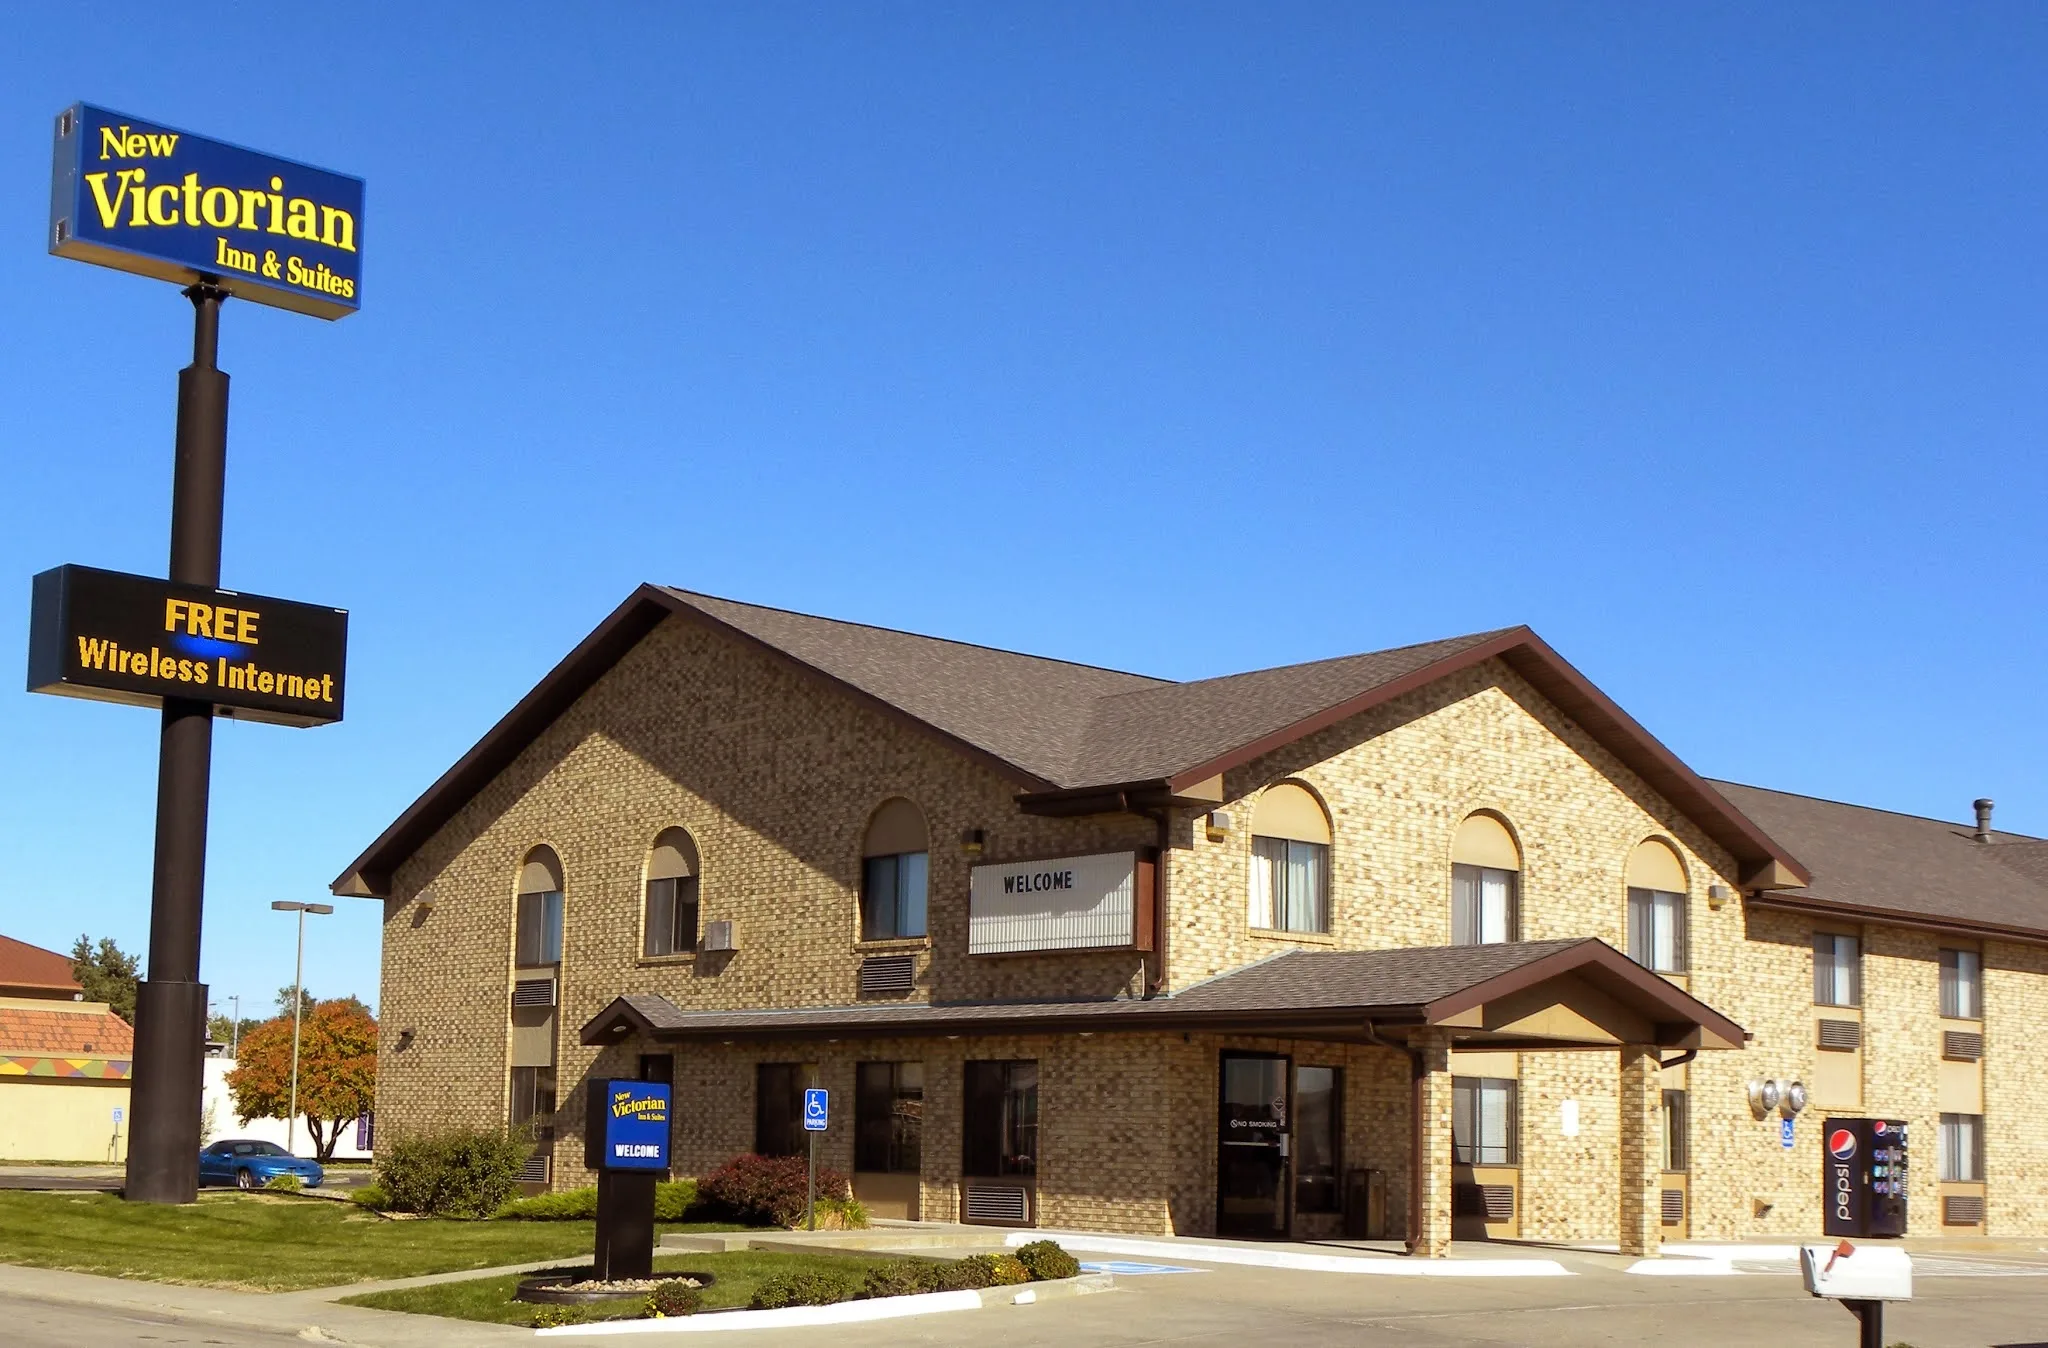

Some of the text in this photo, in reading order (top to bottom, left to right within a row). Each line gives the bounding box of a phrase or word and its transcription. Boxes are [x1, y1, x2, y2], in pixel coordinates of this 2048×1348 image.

[99, 125, 179, 160] New
[85, 167, 357, 252] Victorian
[216, 236, 355, 299] Inn & Suites
[164, 598, 260, 645] FREE
[77, 635, 333, 703] Wireless Internet
[1003, 870, 1073, 894] WELCOME
[611, 1095, 666, 1118] Victorian
[614, 1091, 631, 1103] New
[806, 1118, 826, 1127] PARKING
[1237, 1120, 1277, 1128] NO SMOKING
[614, 1144, 660, 1159] WELCOME
[1834, 1163, 1853, 1221] pepsi
